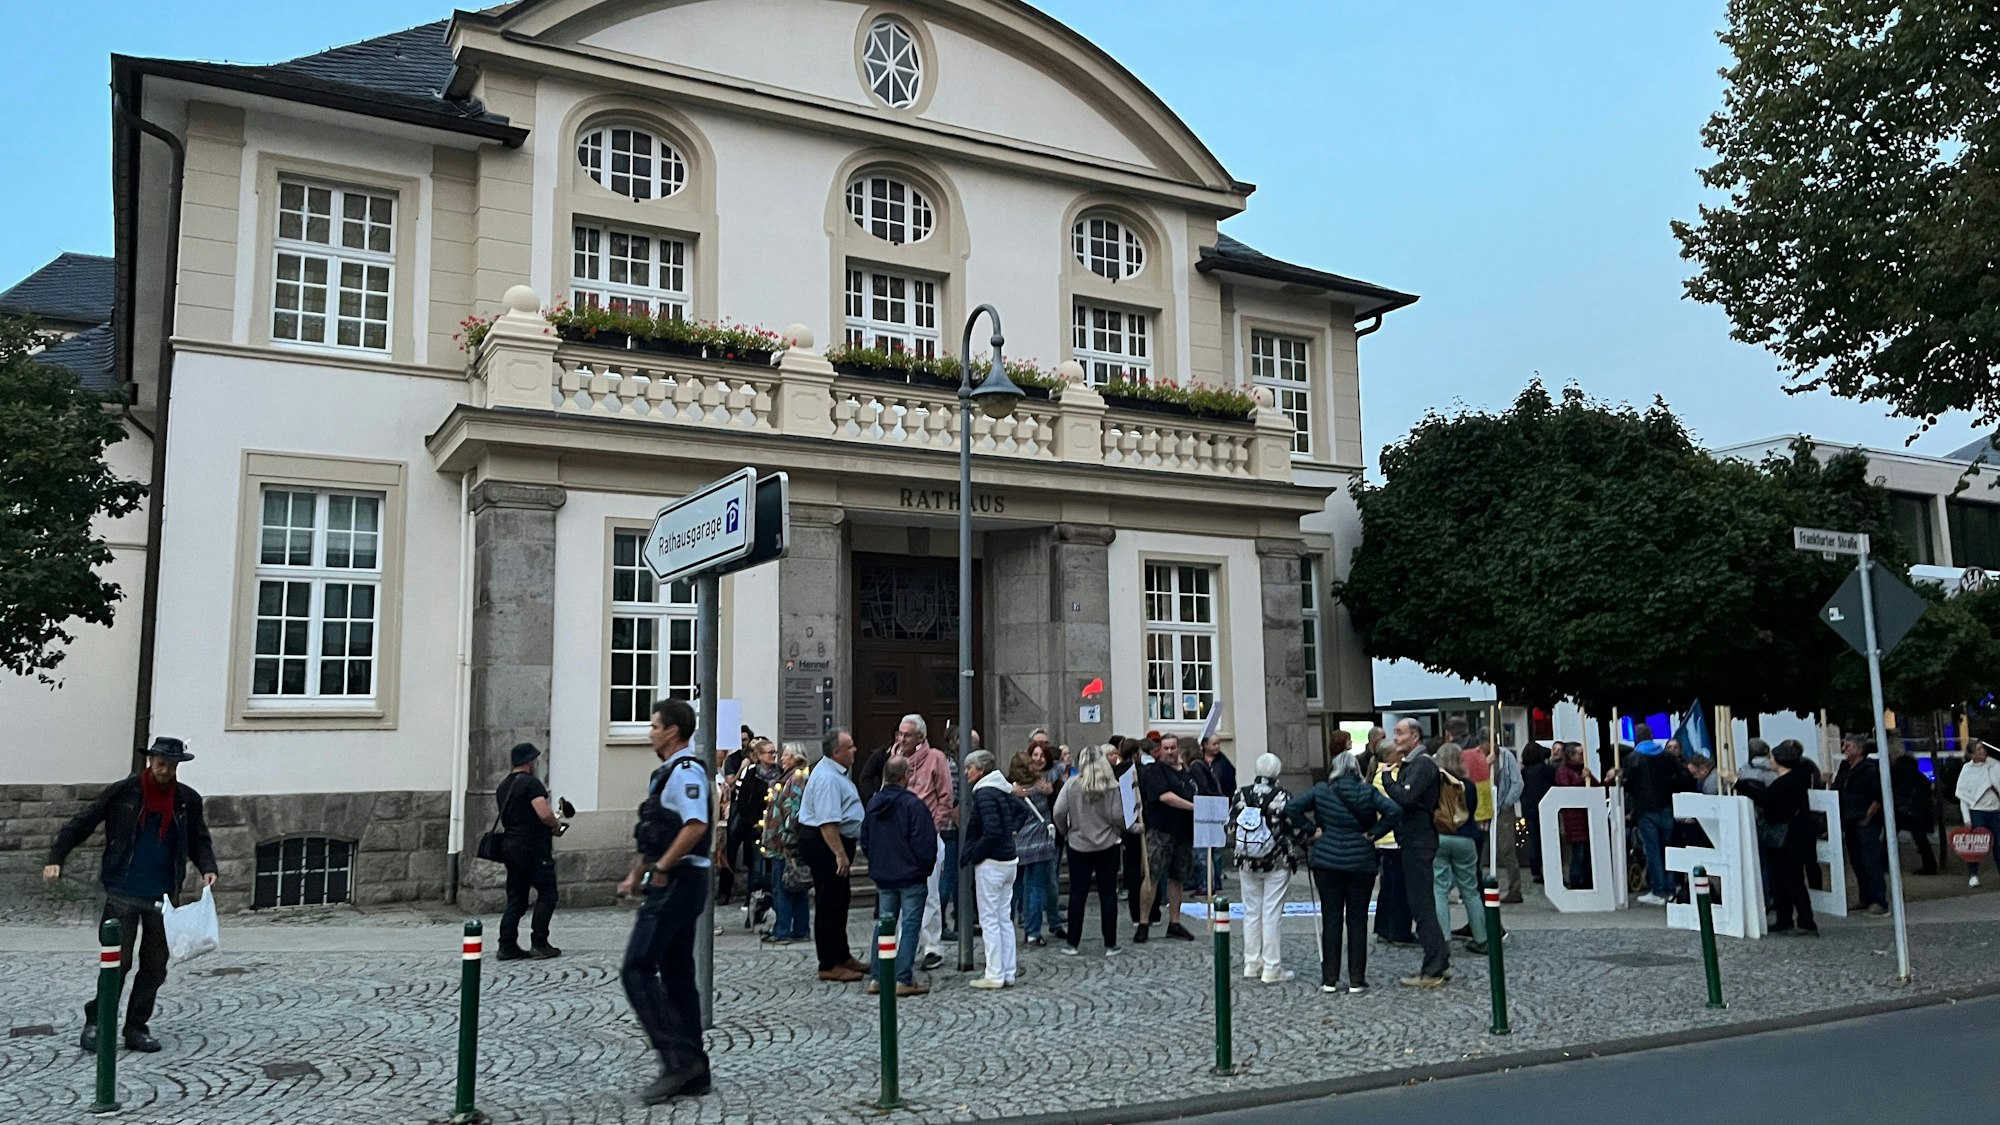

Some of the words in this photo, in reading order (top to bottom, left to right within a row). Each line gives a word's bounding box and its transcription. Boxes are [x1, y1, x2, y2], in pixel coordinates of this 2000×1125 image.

[658, 515, 722, 557] Rathausgarage
[1799, 530, 1835, 547] Frankfurter
[1837, 535, 1858, 550] Straße
[799, 660, 830, 669] Hennef
